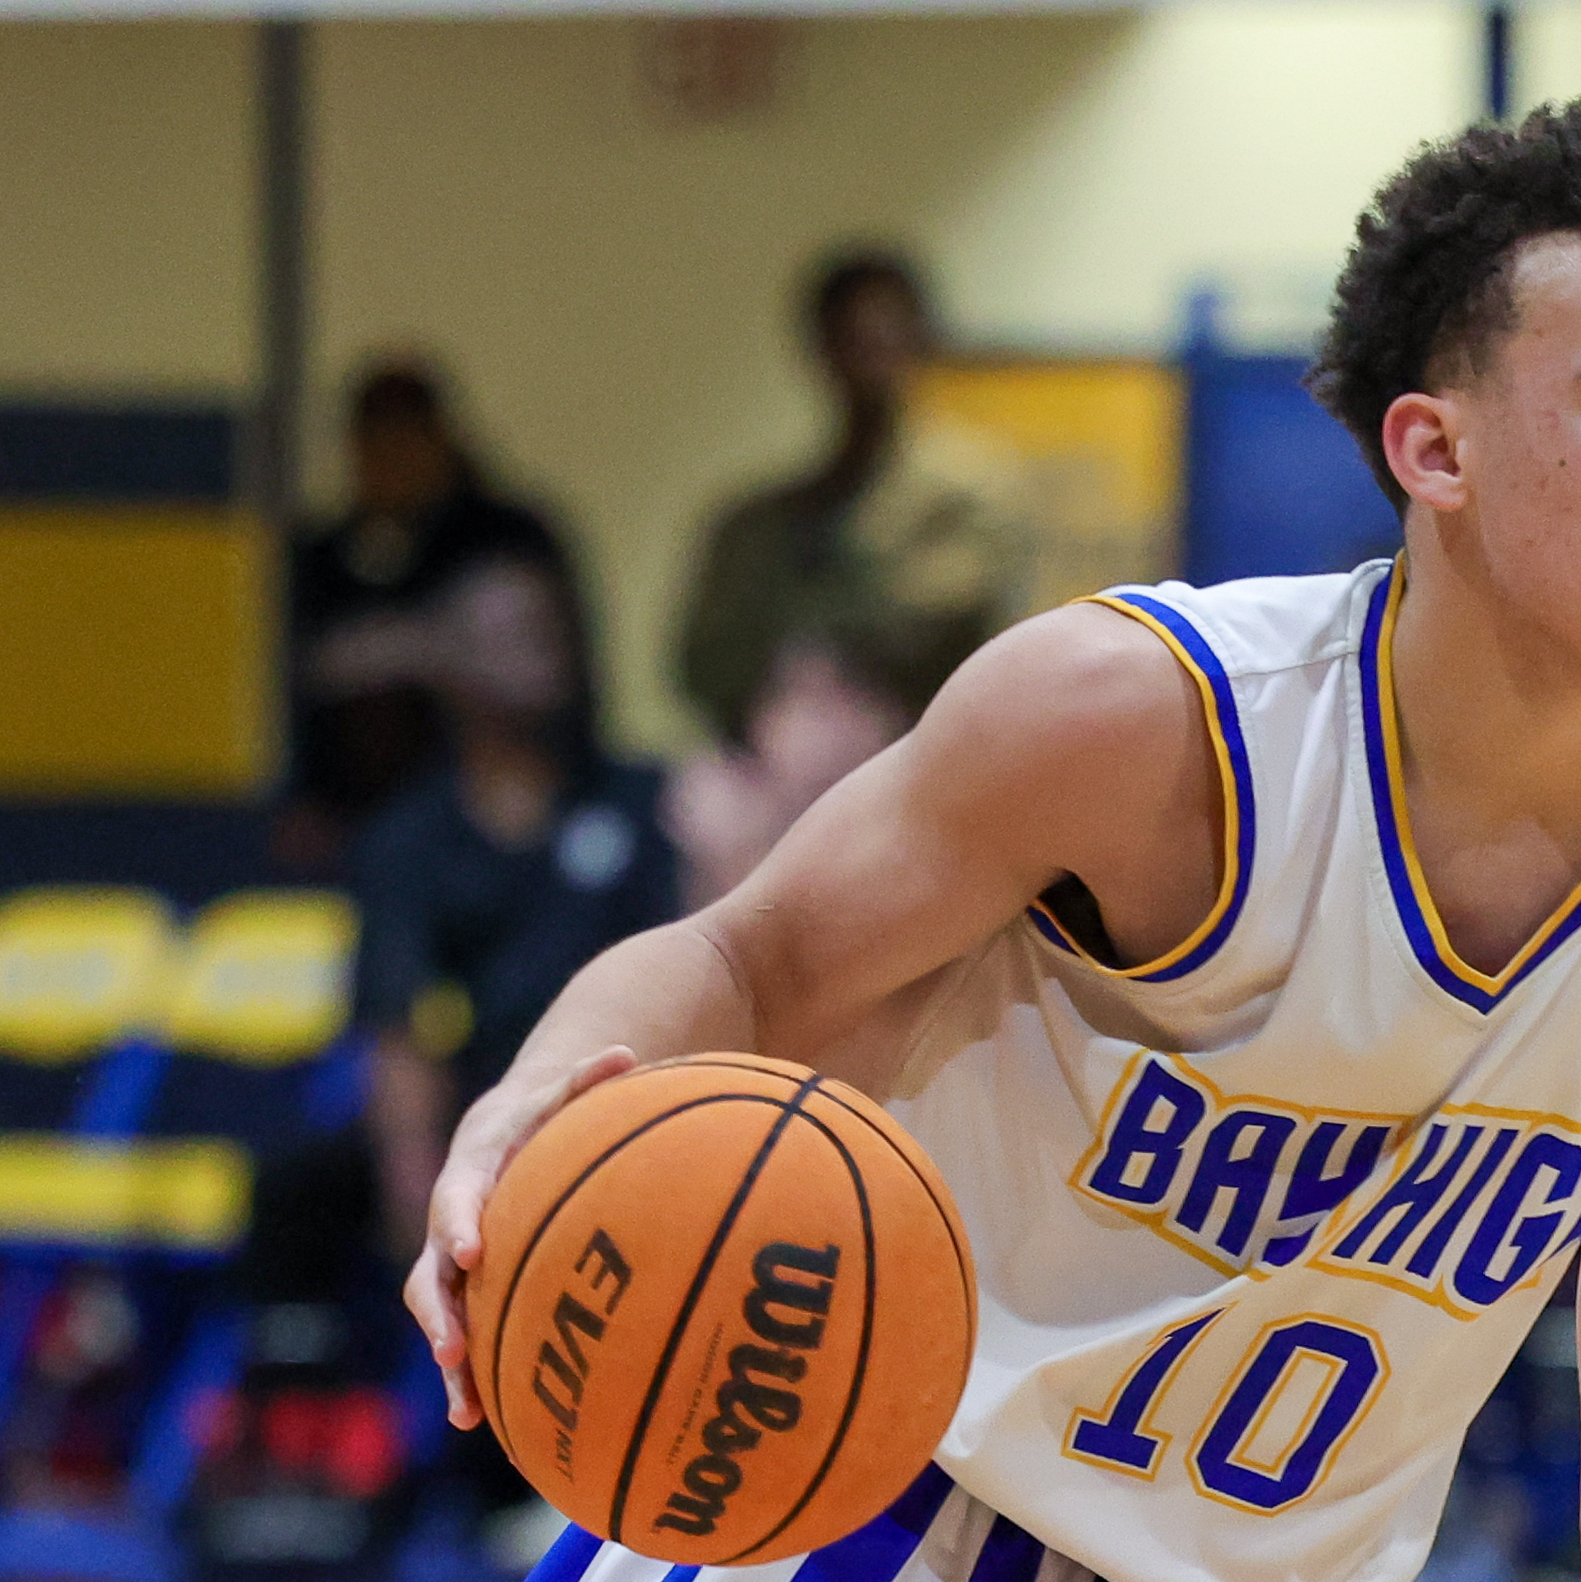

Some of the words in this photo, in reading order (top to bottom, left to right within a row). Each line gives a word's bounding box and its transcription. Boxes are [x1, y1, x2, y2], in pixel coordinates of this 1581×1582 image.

[1085, 1055, 1396, 1270] BAY
[652, 1240, 842, 1538] Wilson
[1069, 1304, 1384, 1512] 10
